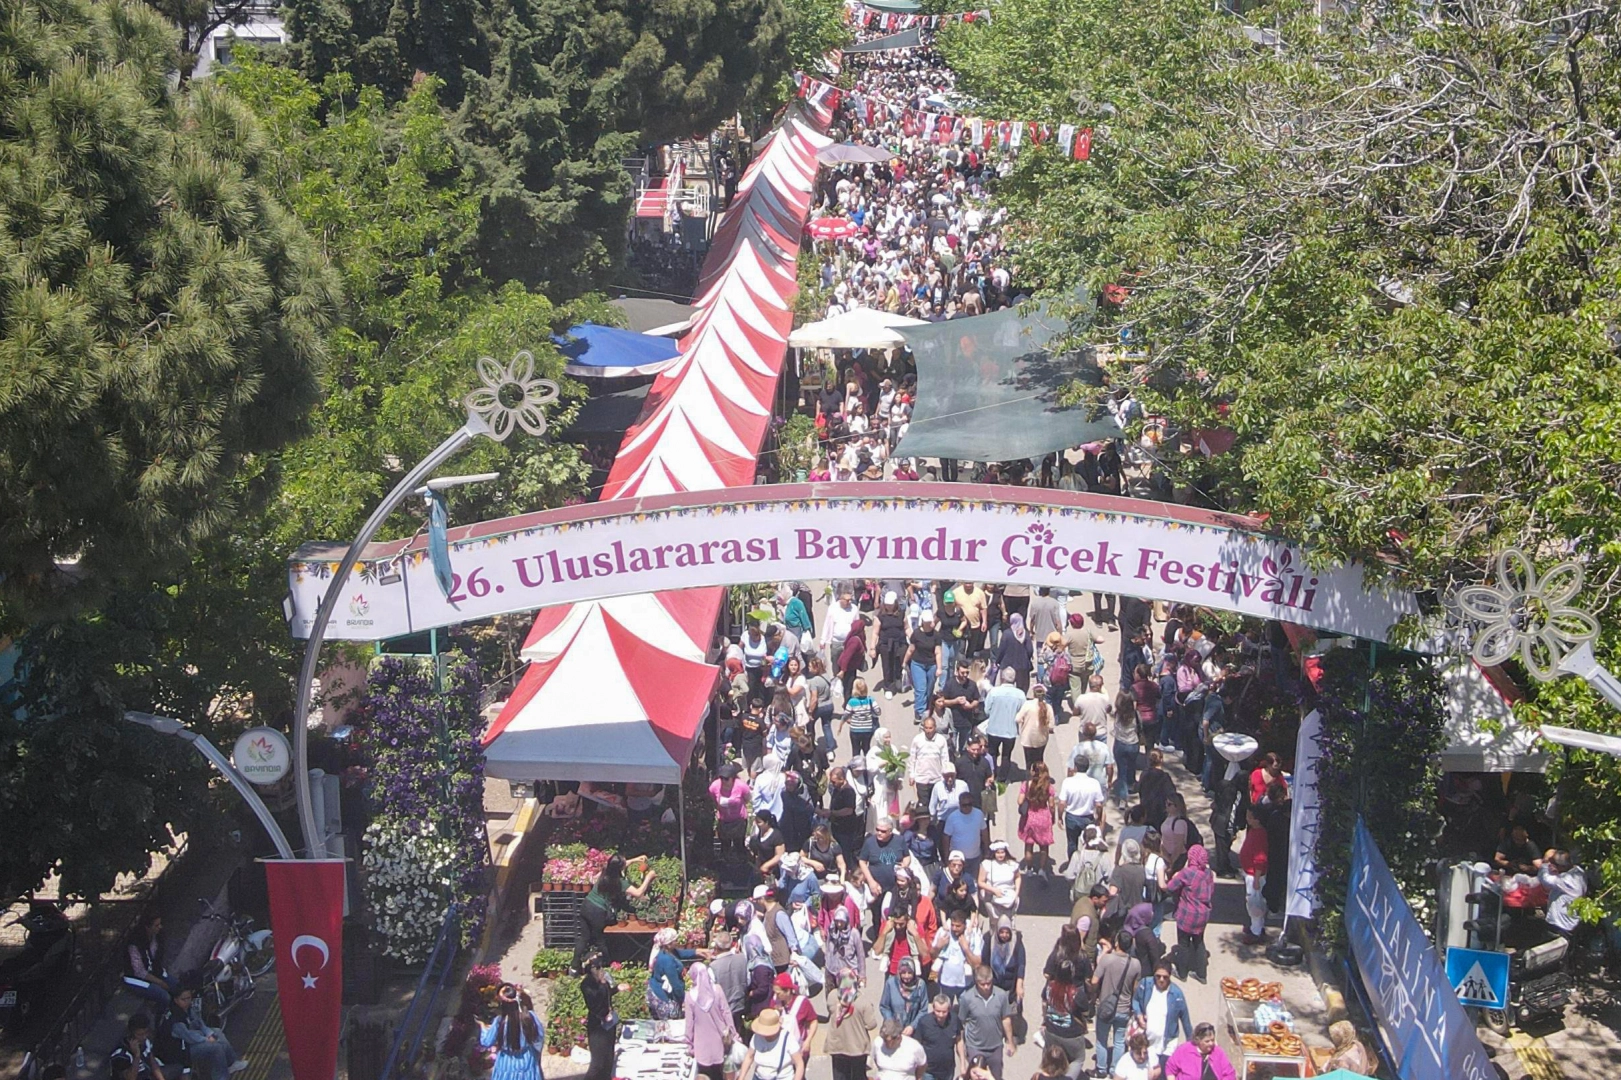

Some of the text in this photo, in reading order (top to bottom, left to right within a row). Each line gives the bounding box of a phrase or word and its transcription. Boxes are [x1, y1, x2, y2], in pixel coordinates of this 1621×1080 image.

[446, 526, 1320, 612] 26. Uluslararası Bayındır Çiçek Festivali
